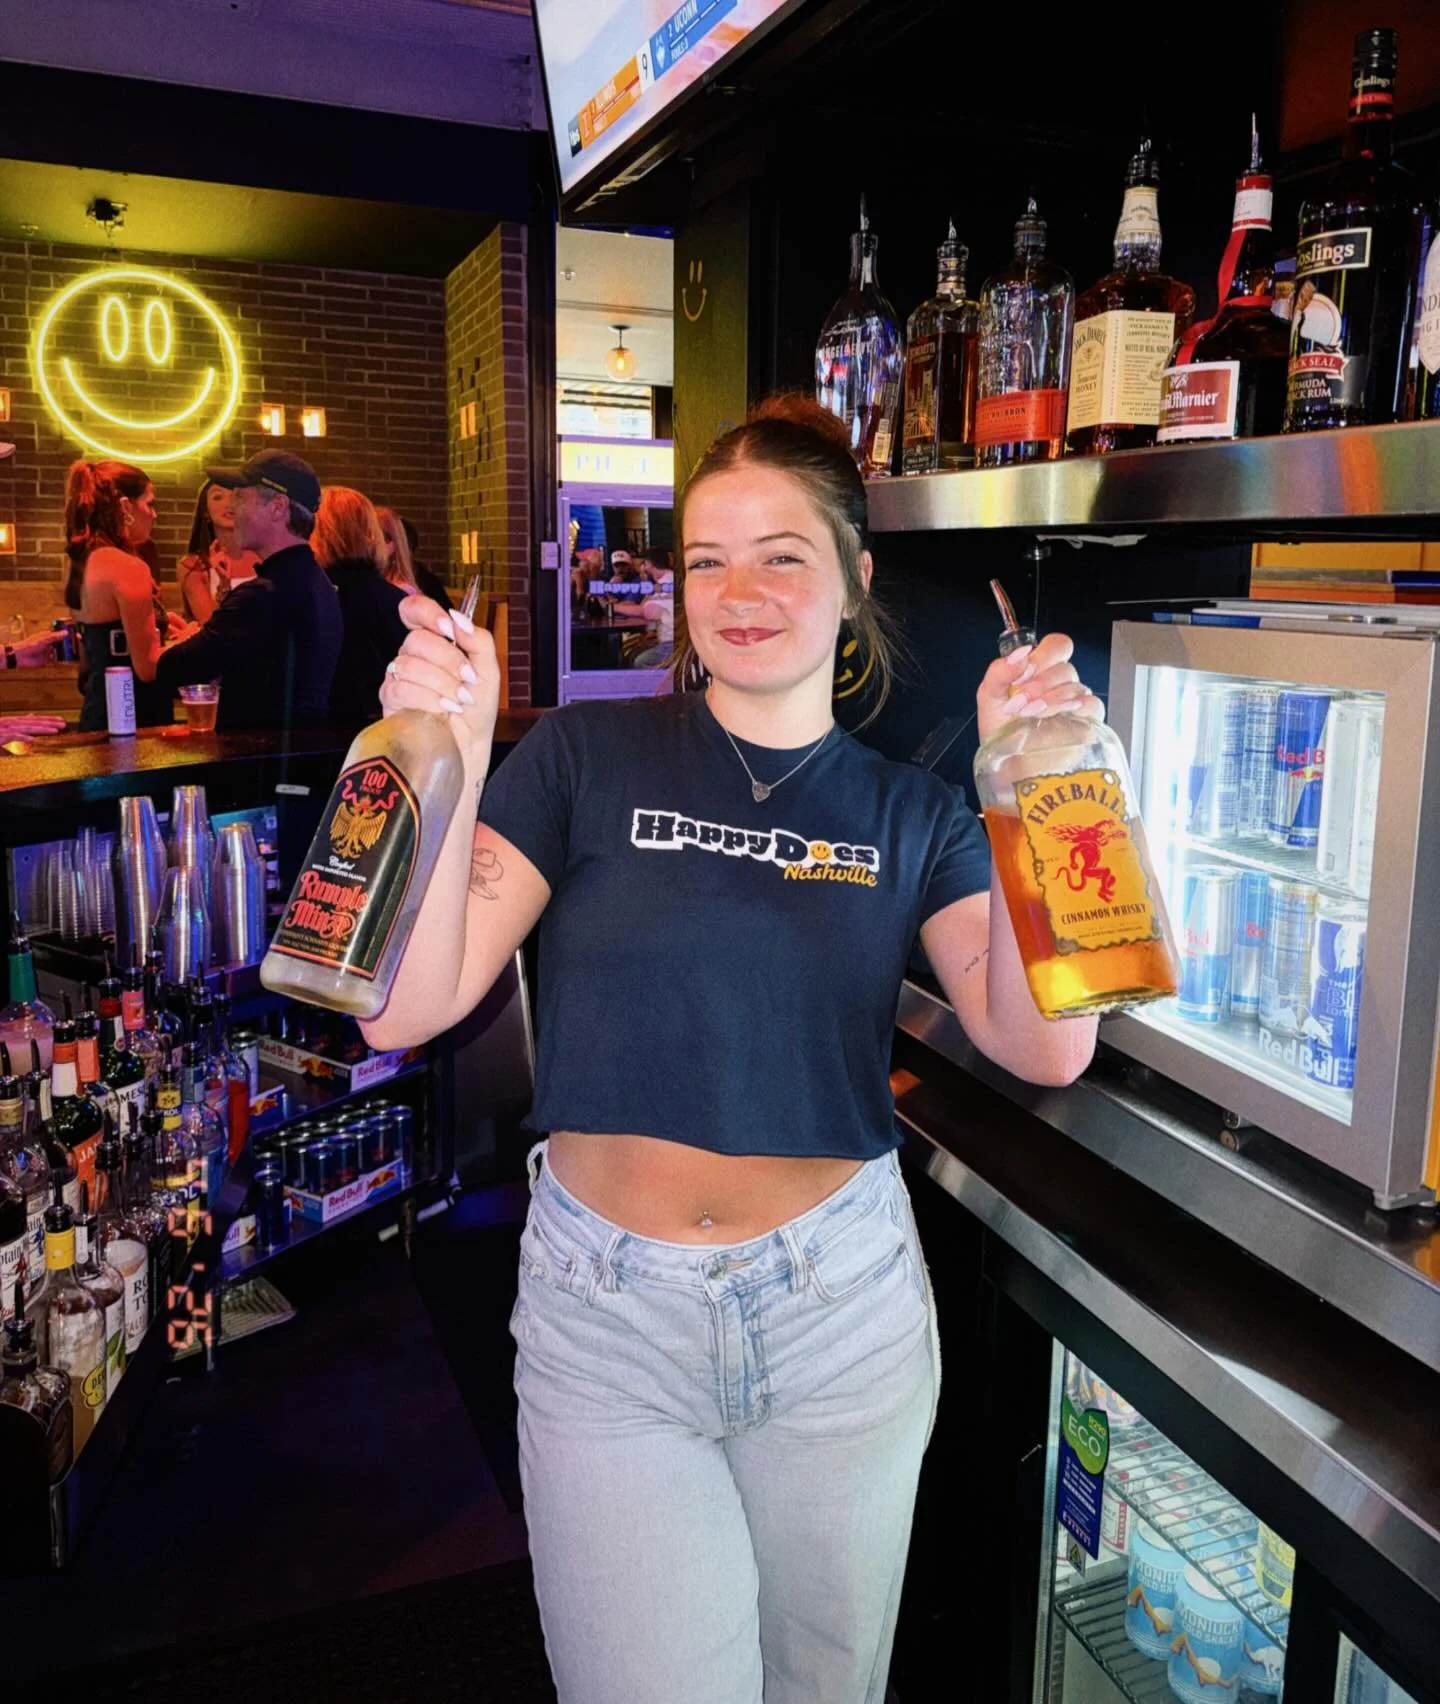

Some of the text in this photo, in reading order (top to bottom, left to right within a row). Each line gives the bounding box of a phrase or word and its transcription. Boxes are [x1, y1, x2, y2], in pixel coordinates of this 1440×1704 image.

[641, 53, 648, 79] 9
[1309, 356, 1336, 368] SEAL
[1307, 387, 1333, 399] RUM
[1275, 743, 1310, 765] Red
[363, 769, 388, 789] 100
[1026, 783, 1120, 826] FIREBALL
[784, 863, 878, 888] Nashville
[299, 869, 369, 913] Rumple
[1061, 903, 1147, 926] CINNAMON WHISKY
[258, 1038, 296, 1061] Red Bull
[1259, 1027, 1340, 1086] Red Bull
[357, 1062, 375, 1078] Red
[328, 1183, 363, 1208] Red Bull
[1068, 1414, 1101, 1457] ECO
